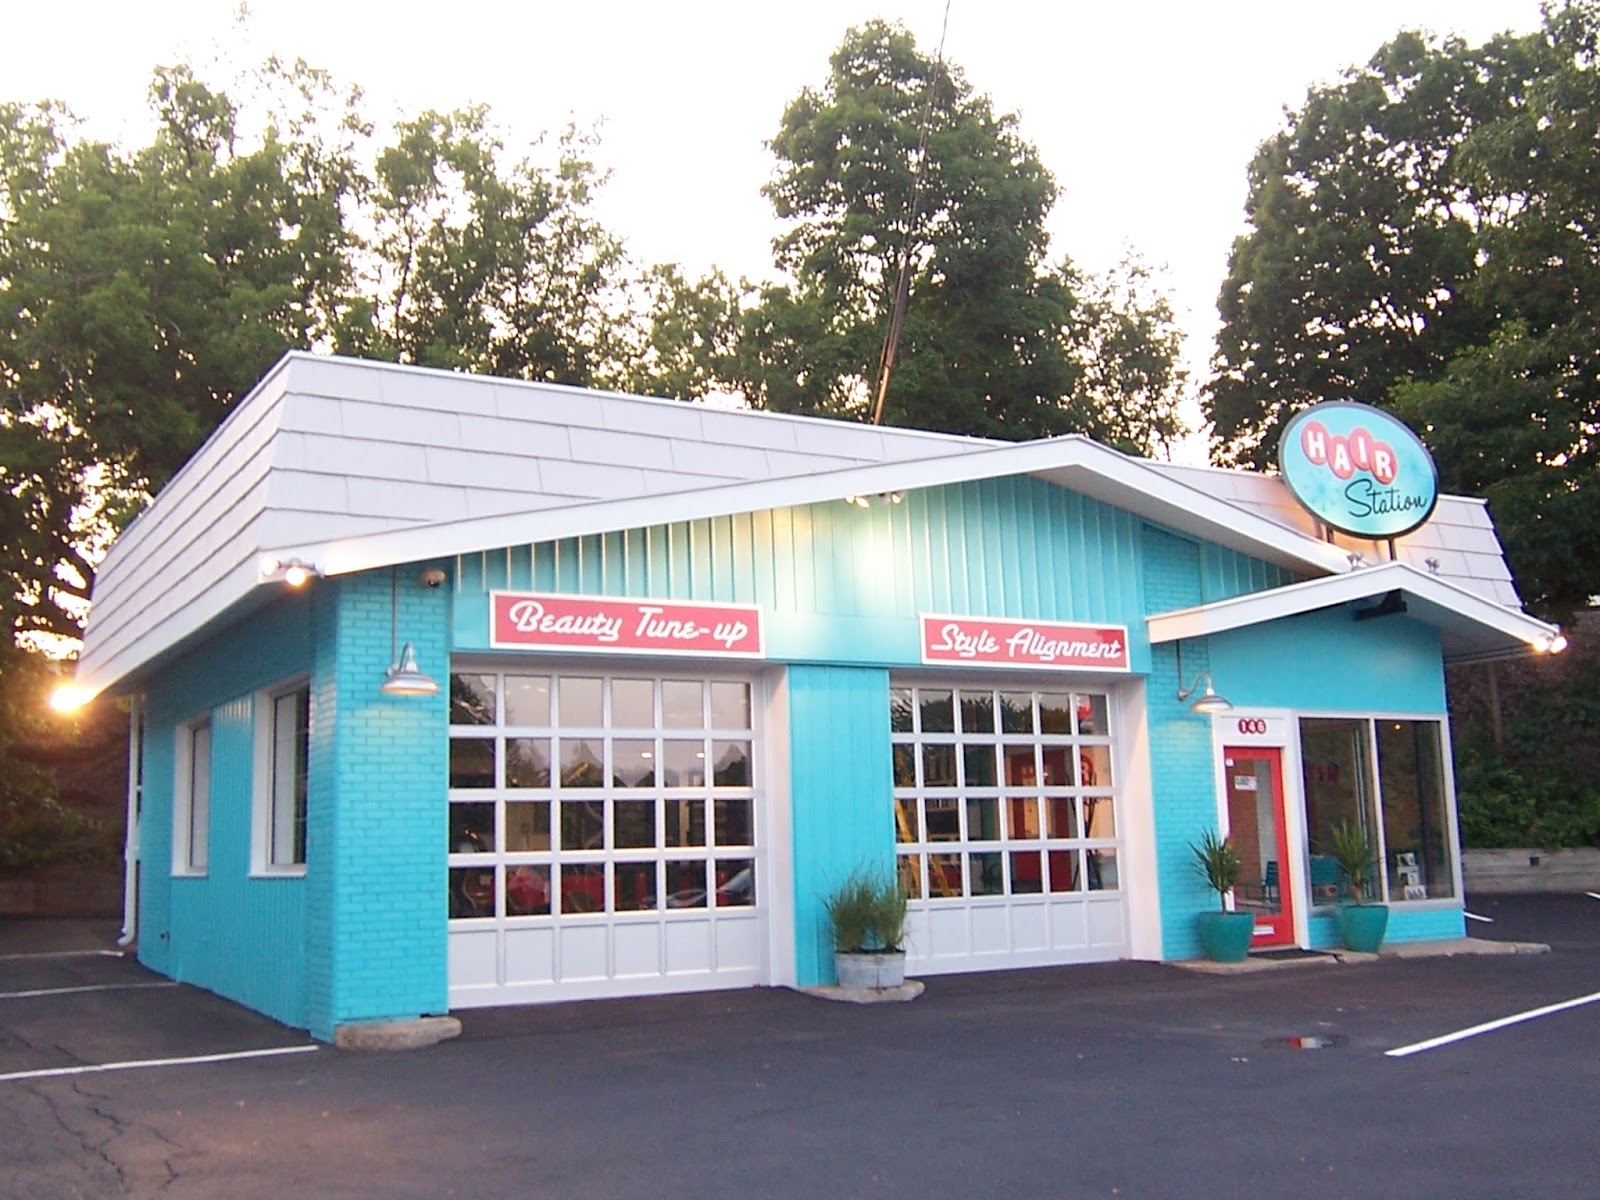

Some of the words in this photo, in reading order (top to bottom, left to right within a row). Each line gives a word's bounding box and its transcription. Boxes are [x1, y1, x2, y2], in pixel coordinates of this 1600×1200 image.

[1307, 431, 1392, 478] HAIR
[1345, 478, 1427, 518] Station
[509, 601, 622, 642] Beauty
[635, 607, 748, 649] Tune-up
[931, 624, 999, 658] Style
[1006, 628, 1121, 661] Alignment
